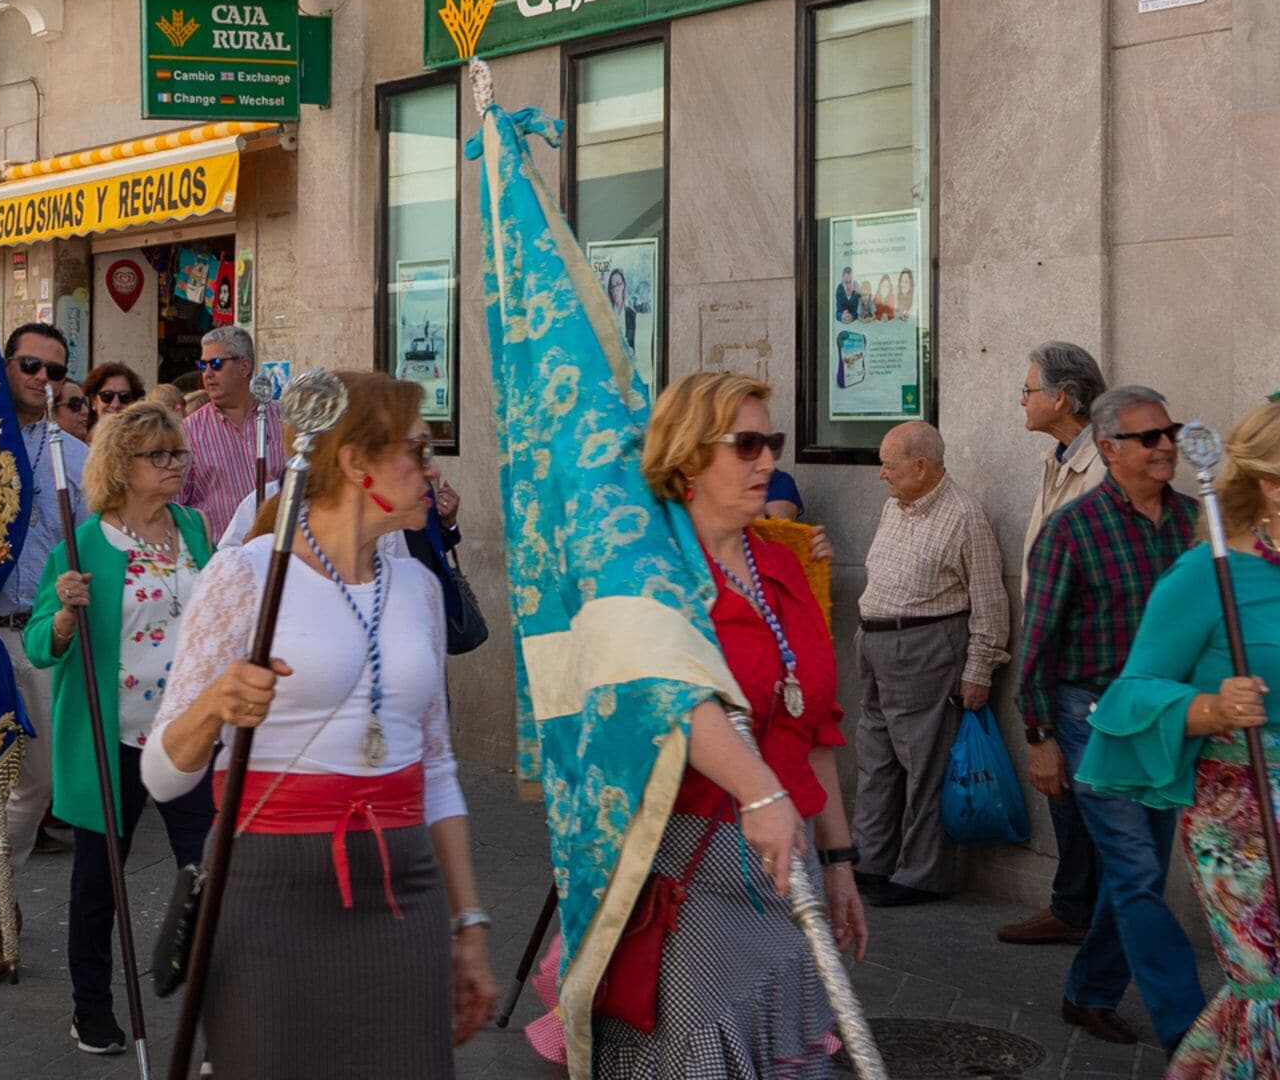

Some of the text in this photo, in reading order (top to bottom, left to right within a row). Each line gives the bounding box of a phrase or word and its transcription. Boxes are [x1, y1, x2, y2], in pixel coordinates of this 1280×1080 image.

[211, 4, 269, 26] CAJA
[212, 30, 292, 51] RURAL
[173, 70, 291, 85] Cambio Exchange
[173, 93, 285, 106] Change Wechsel
[96, 185, 108, 223] Y
[118, 166, 207, 219] REGALOS
